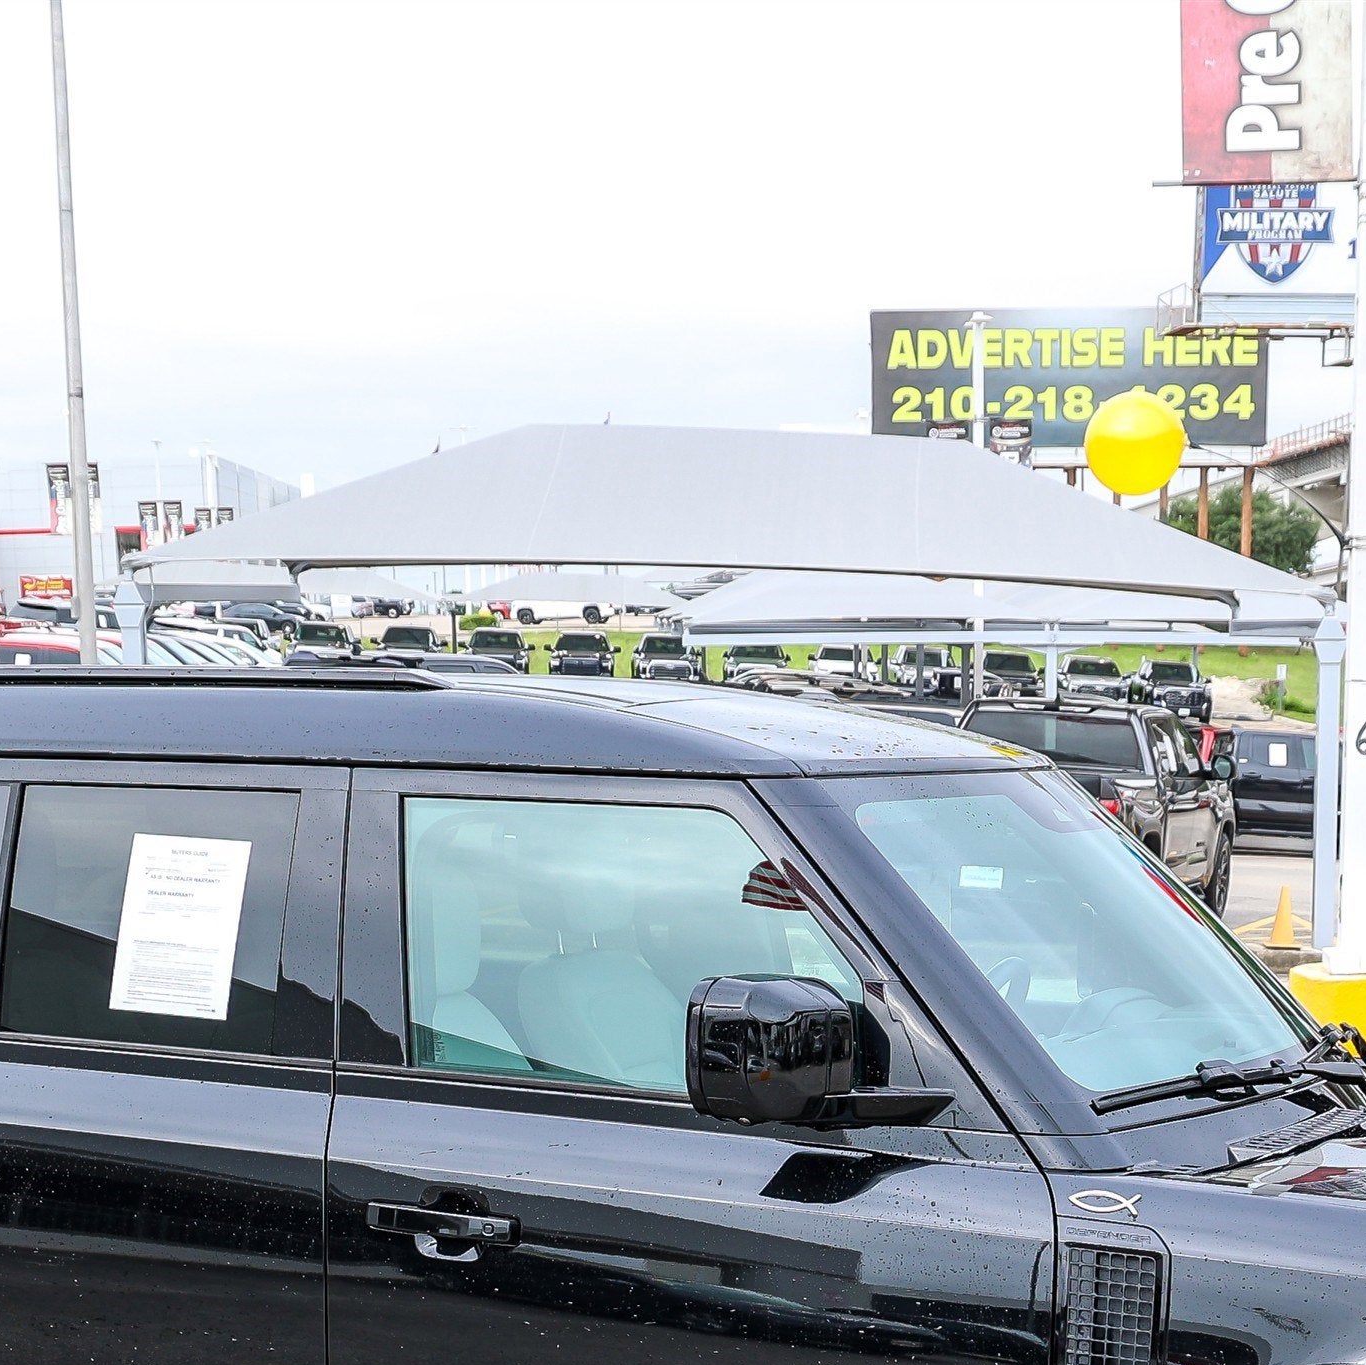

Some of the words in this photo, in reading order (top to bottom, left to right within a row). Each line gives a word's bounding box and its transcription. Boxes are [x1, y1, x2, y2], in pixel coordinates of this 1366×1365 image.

[1225, 29, 1302, 152] Pre
[1253, 189, 1299, 199] SALUTE
[1223, 211, 1330, 233] MILITARY
[887, 327, 1125, 370] ADVERTISE
[1142, 327, 1260, 367] HERE
[891, 384, 1256, 423] 210-218234
[167, 890, 194, 898] WARRANTY
[1065, 1226, 1152, 1246] DEFENDER
